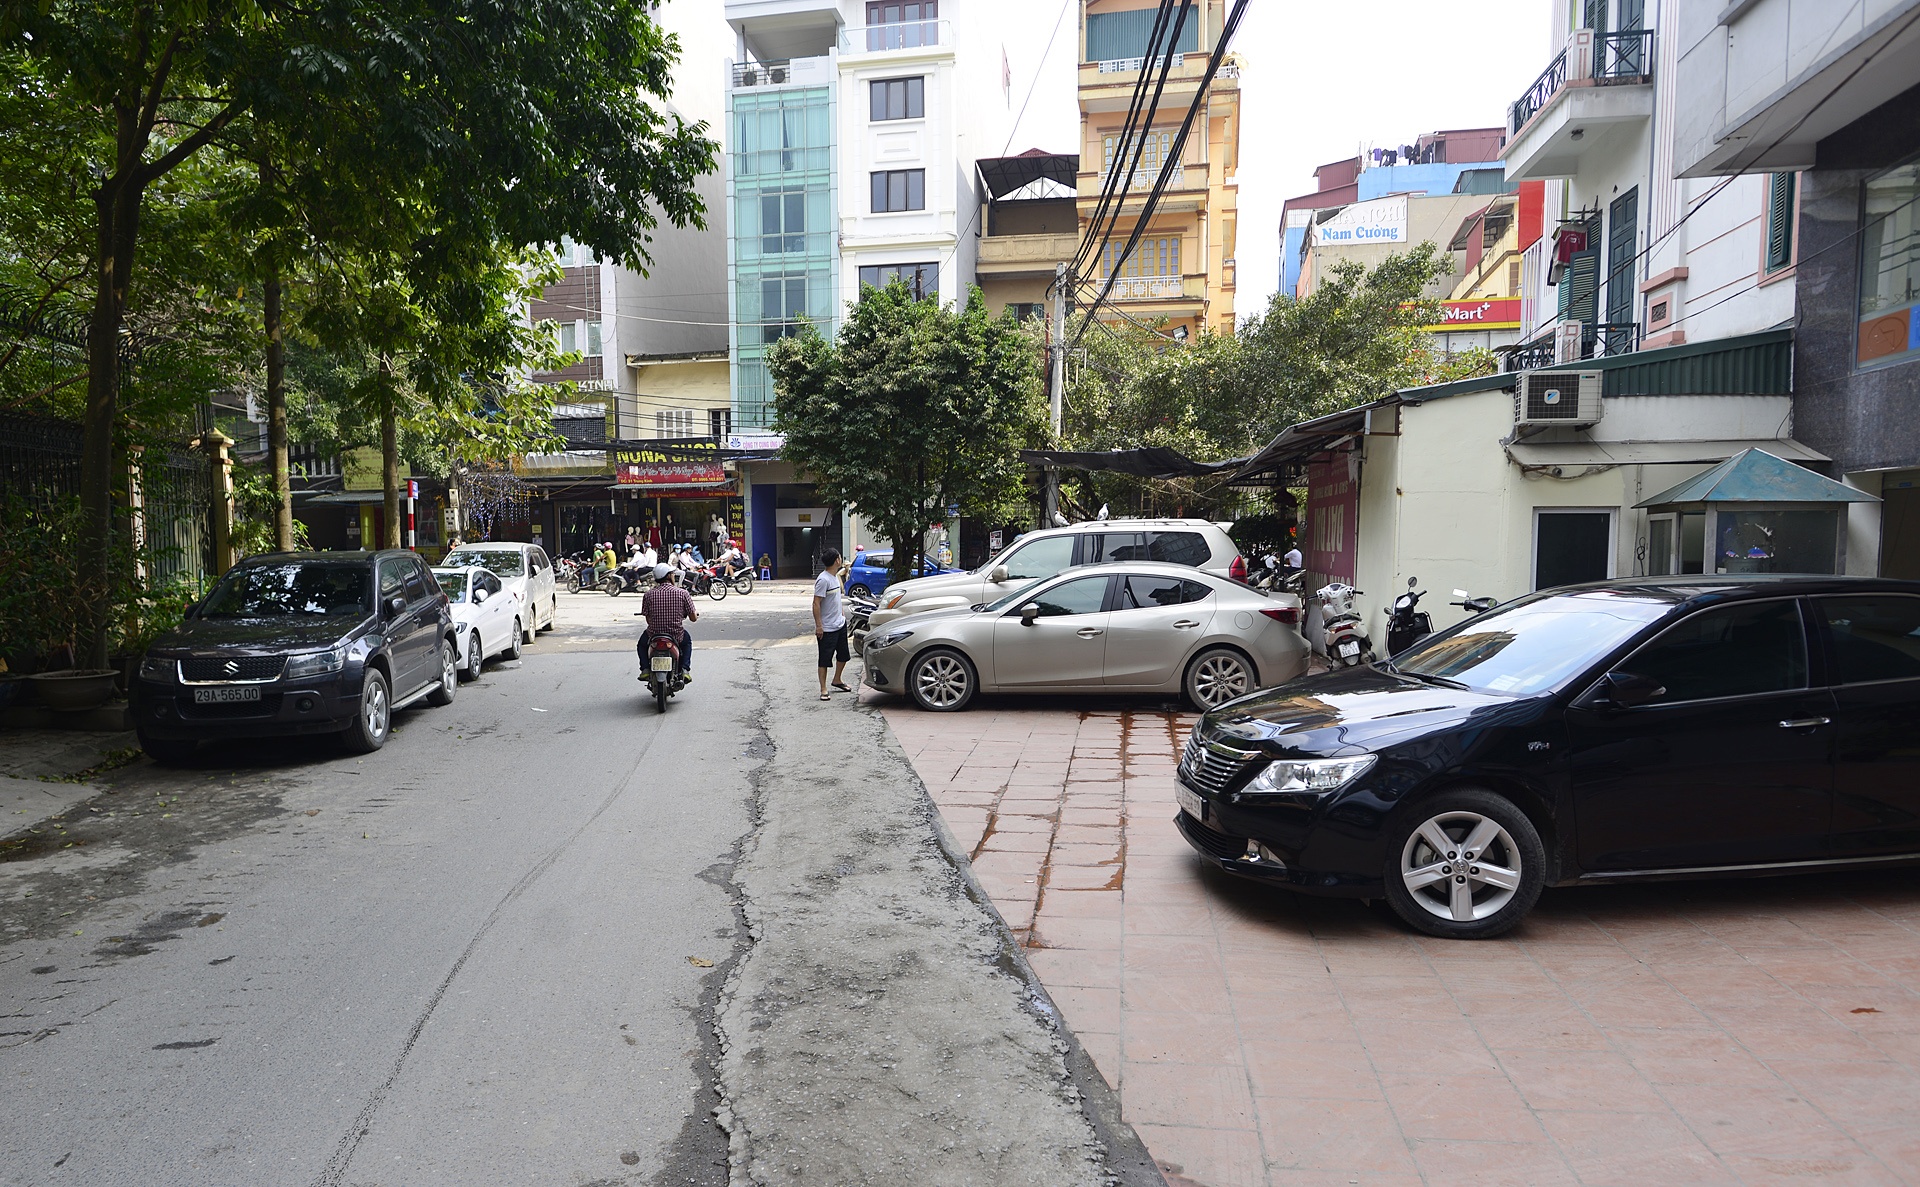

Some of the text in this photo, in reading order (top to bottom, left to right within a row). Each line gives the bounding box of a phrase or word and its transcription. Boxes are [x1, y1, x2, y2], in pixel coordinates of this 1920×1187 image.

[1322, 224, 1398, 240] Nam Cường
[196, 688, 259, 702] 29A-565.00
